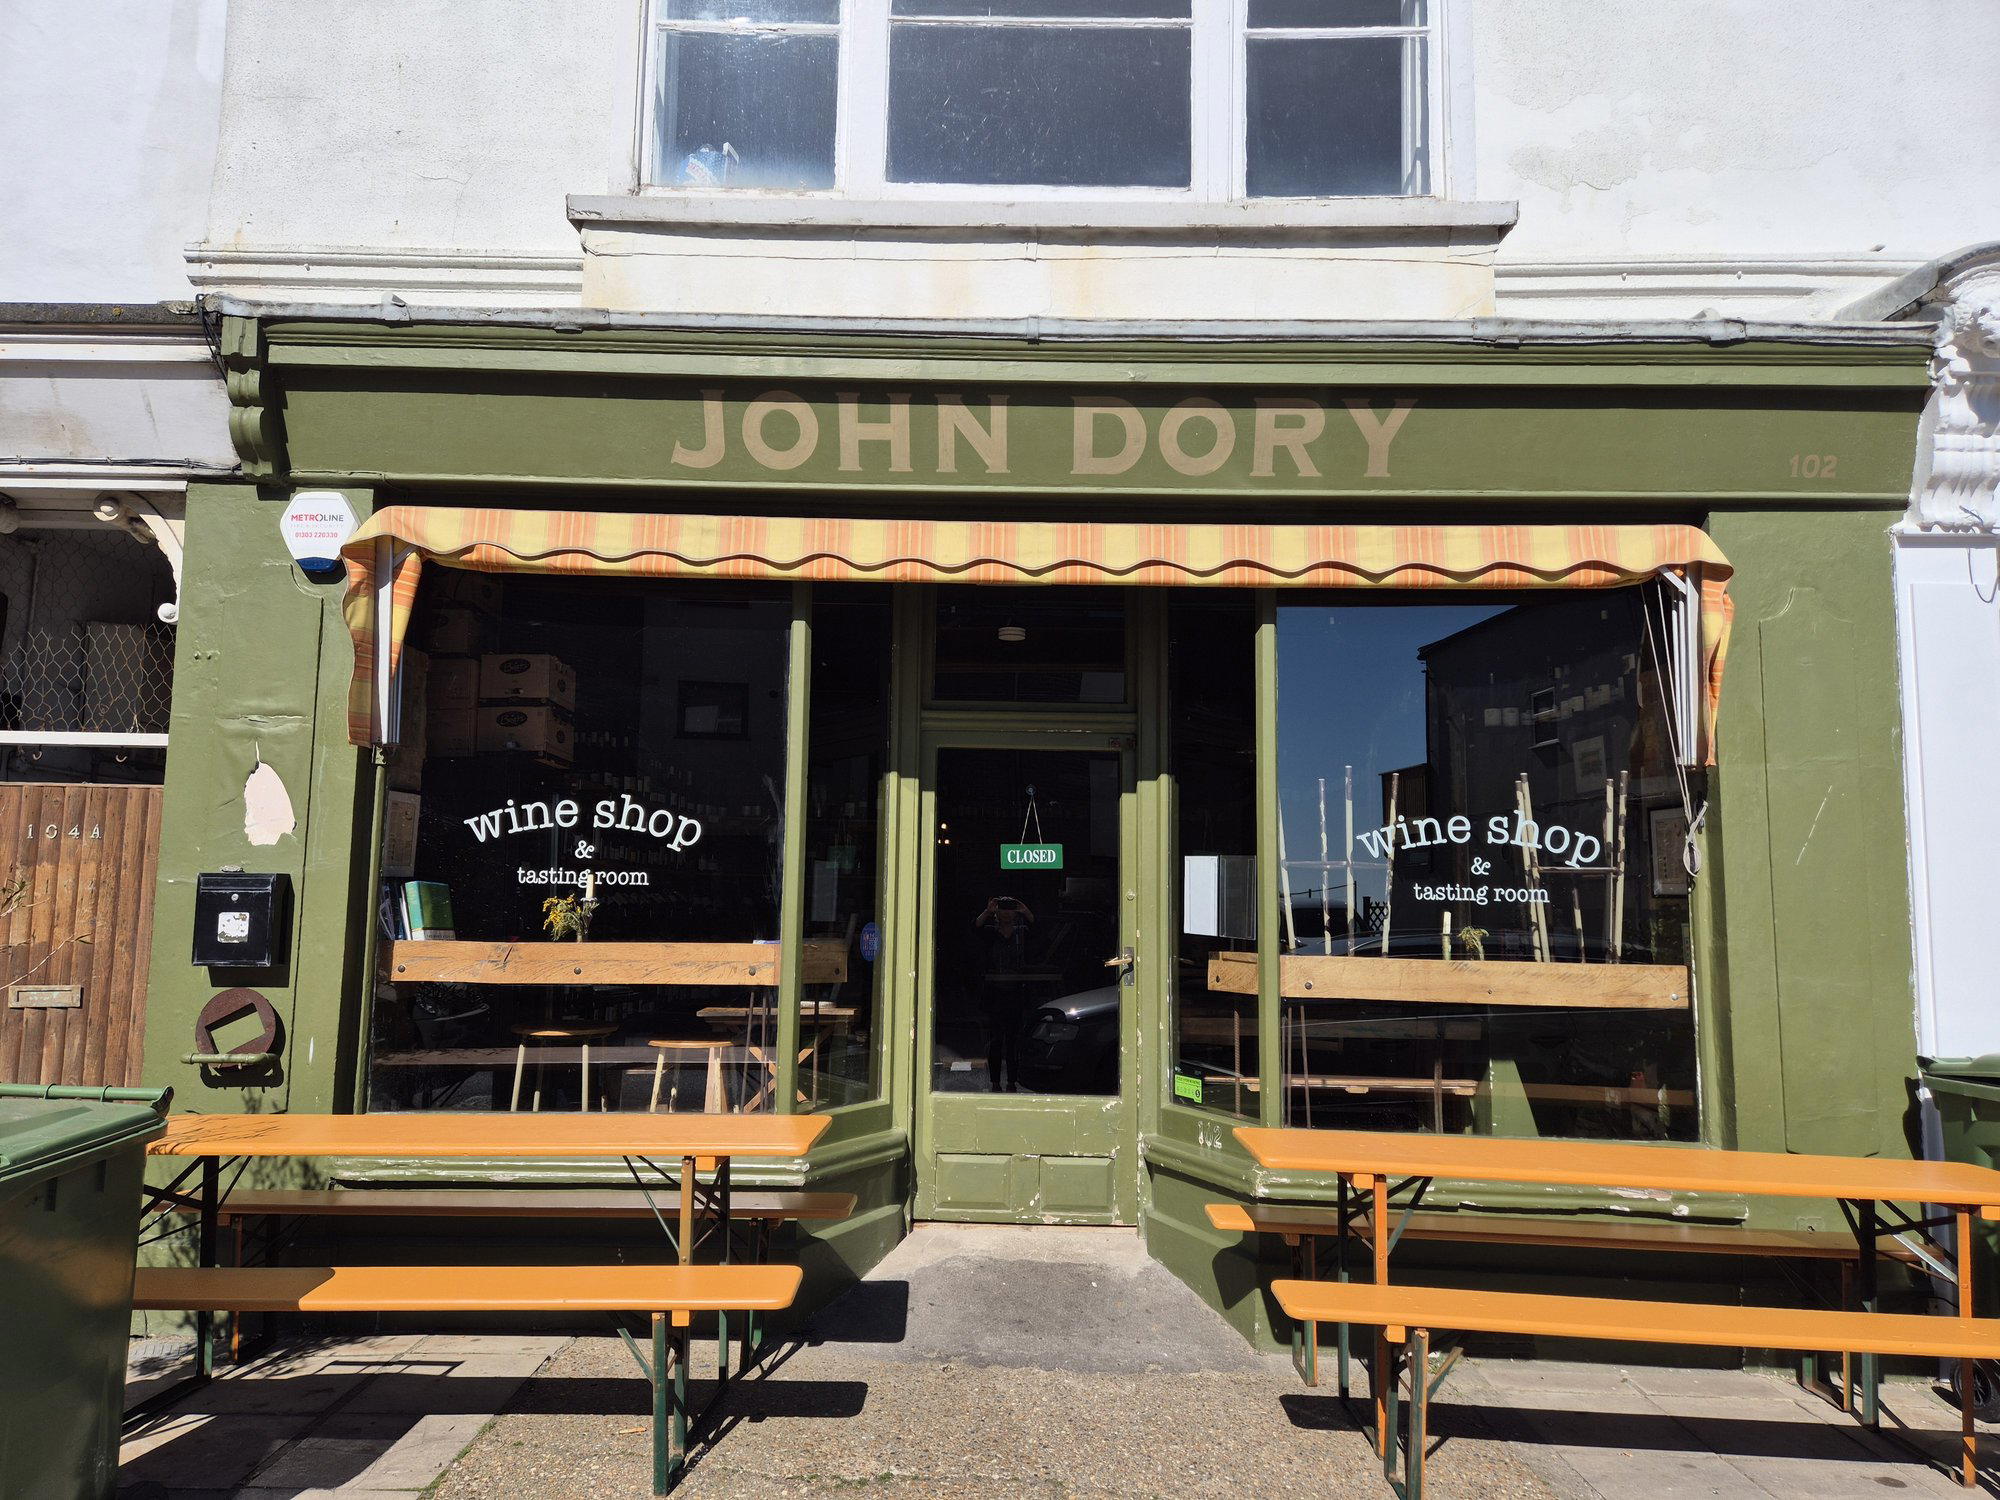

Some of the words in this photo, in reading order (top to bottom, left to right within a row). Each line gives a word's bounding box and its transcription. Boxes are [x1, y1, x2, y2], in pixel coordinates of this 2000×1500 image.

[670, 389, 1011, 473] JOHN
[1070, 396, 1419, 478] DORY
[1789, 454, 1839, 478] 102
[290, 513, 344, 522] METROLINE
[26, 824, 101, 839] 104A
[463, 799, 579, 843] wine
[593, 793, 702, 852] shop
[574, 840, 595, 859] &
[1356, 814, 1471, 859] wine
[1487, 809, 1600, 868] shop
[1007, 849, 1057, 863] CLOSED
[1470, 856, 1491, 875] &
[517, 866, 591, 888] tasting
[595, 869, 649, 886] room
[1413, 882, 1489, 906] tasting
[1493, 886, 1550, 904] room
